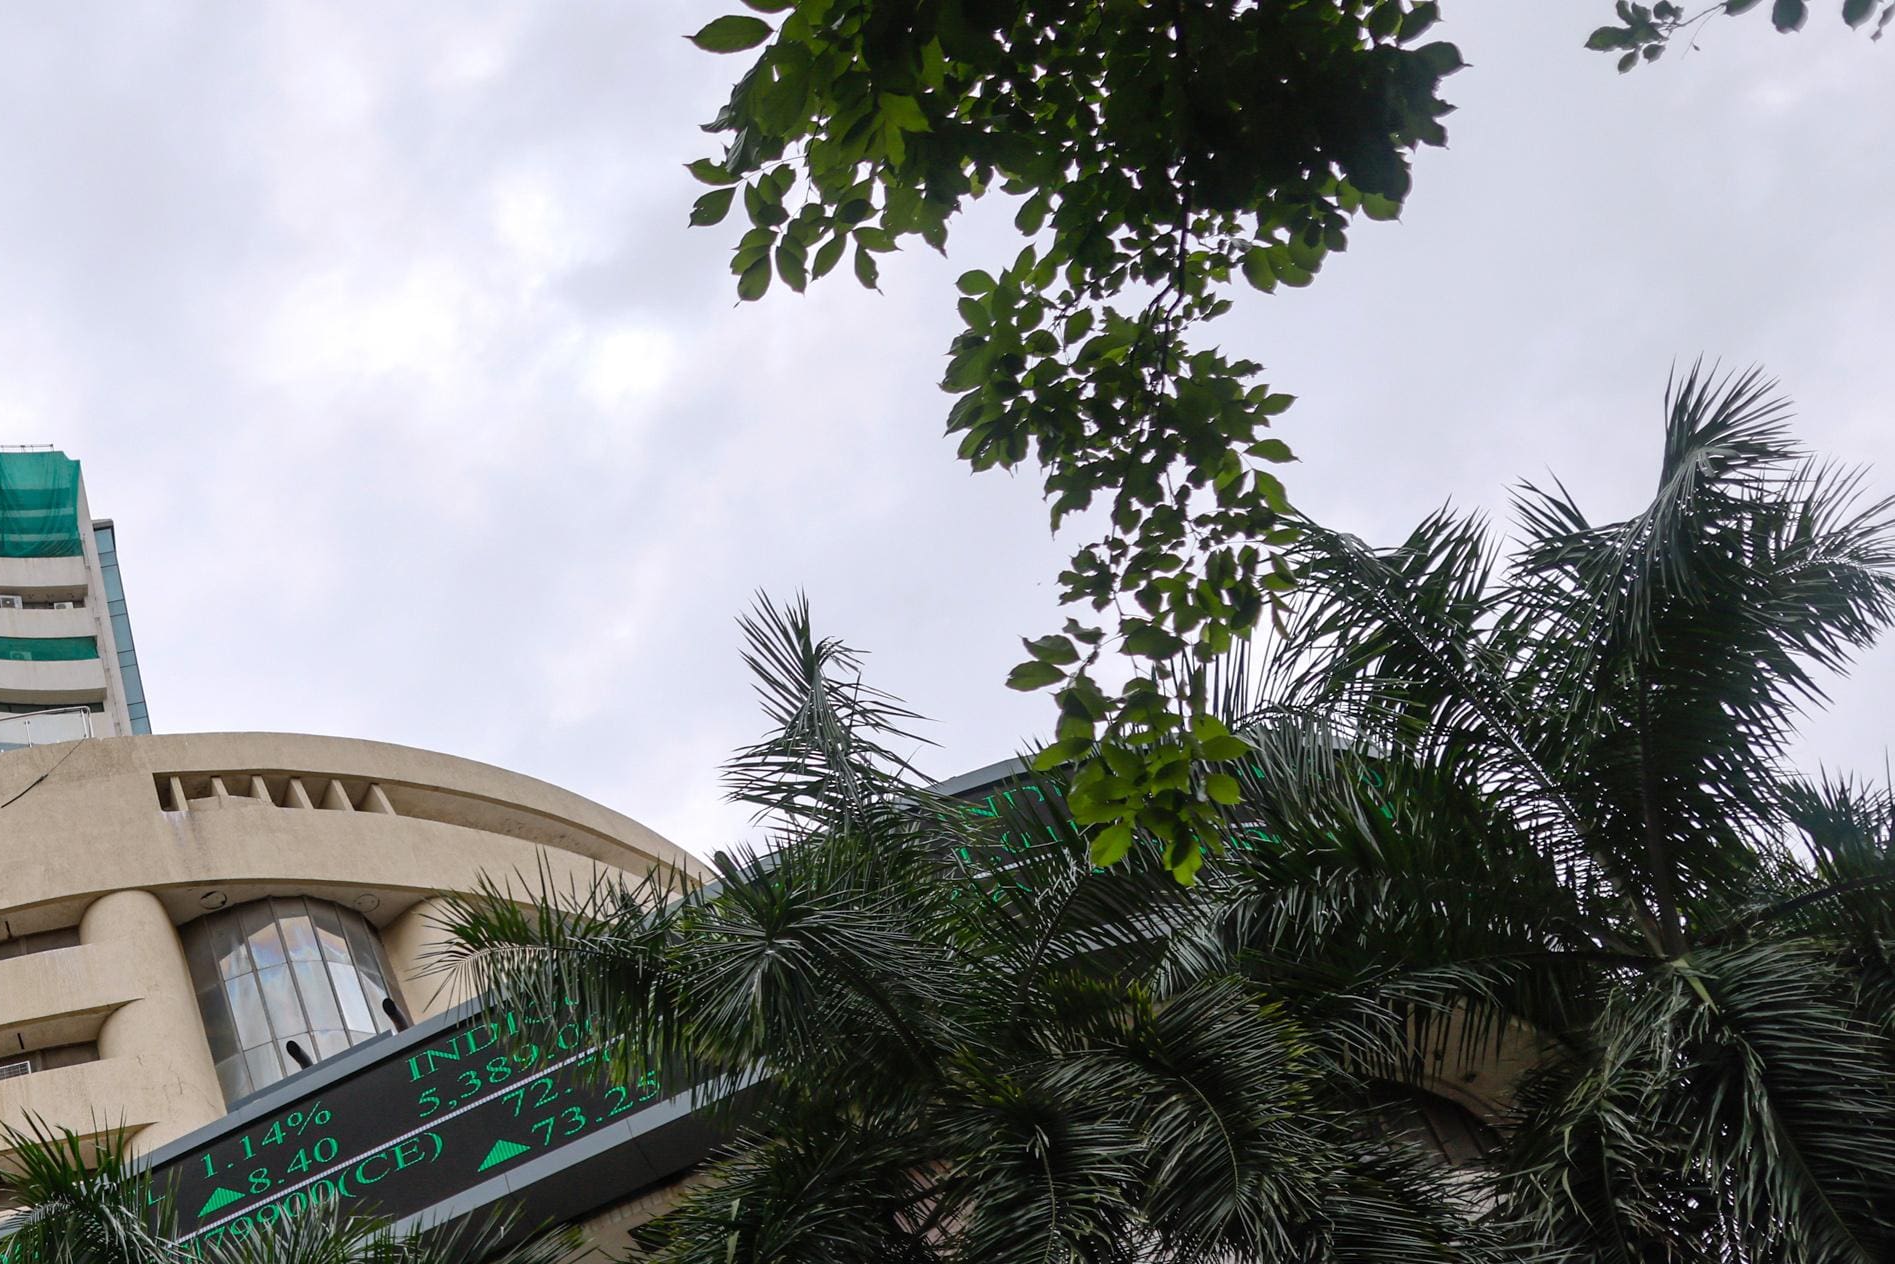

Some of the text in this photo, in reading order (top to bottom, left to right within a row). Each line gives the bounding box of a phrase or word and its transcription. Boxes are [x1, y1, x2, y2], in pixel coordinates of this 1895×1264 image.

[204, 1101, 331, 1179] 1.14%
[531, 1070, 661, 1146] 73.25
[248, 1136, 339, 1194] 8.40
